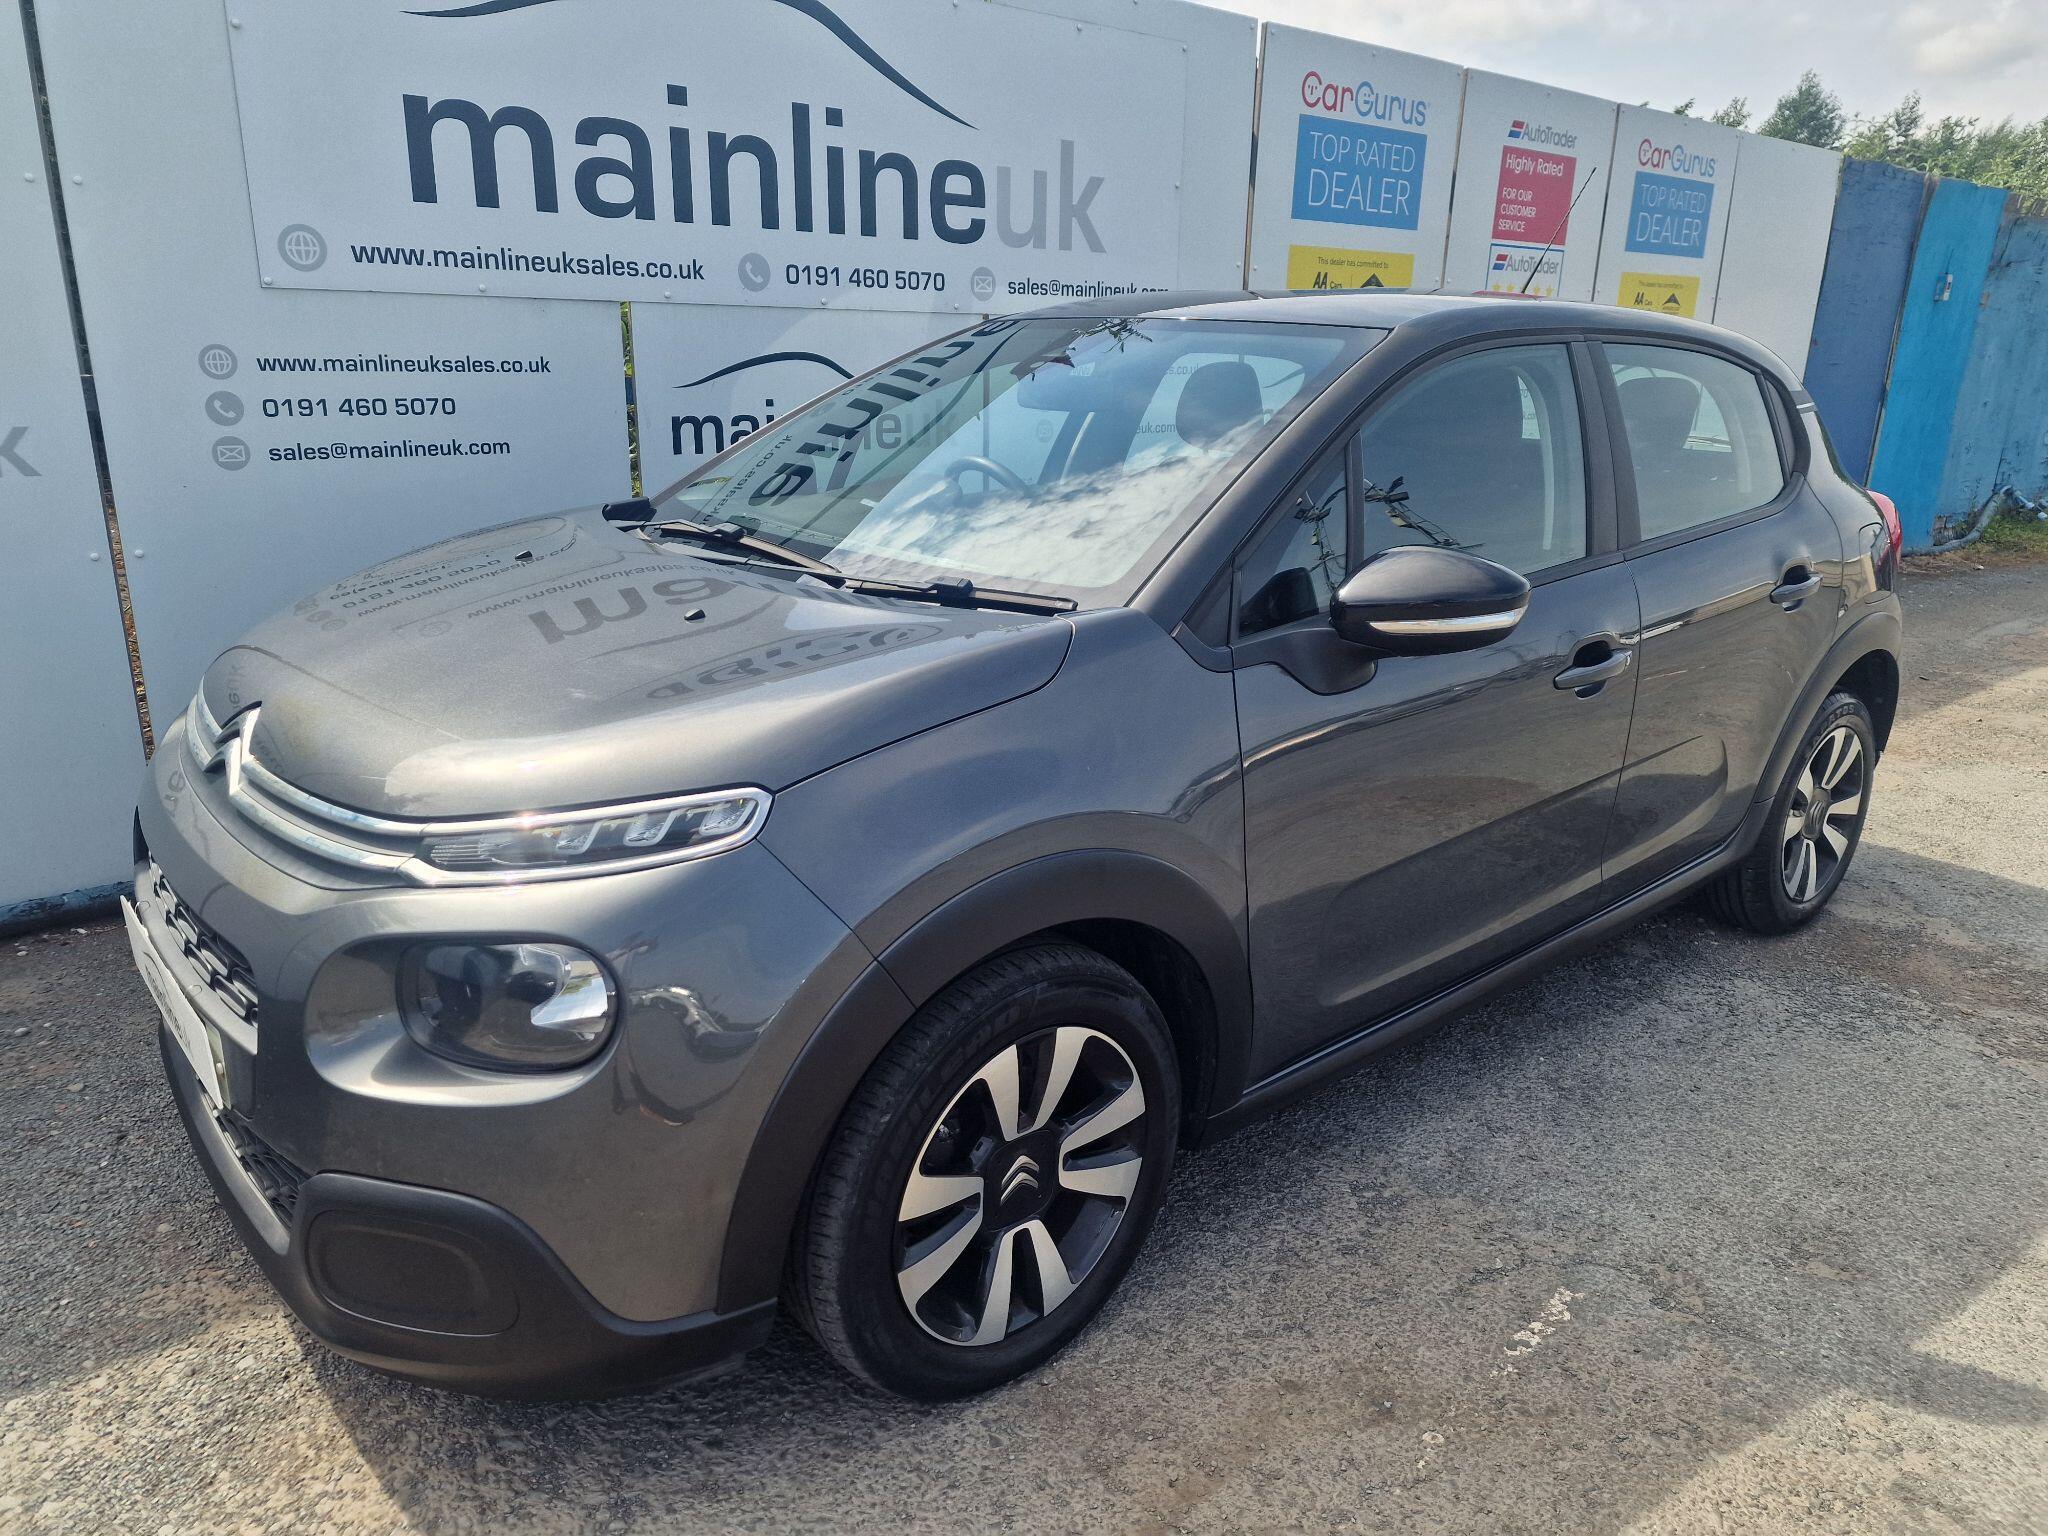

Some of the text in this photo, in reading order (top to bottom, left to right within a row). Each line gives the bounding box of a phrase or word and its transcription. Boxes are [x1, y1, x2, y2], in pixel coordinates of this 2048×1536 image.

[1302, 71, 1427, 126] CarGurus
[1521, 124, 1578, 149] AutoTrader
[1310, 131, 1416, 173] TOP RATED
[1506, 153, 1564, 177] Highly Rated
[1638, 138, 1716, 177] CarGurus
[402, 84, 1107, 253] mainlineuk
[1308, 168, 1411, 216] DEALER
[1502, 187, 1533, 202] FOR OUR
[1641, 184, 1707, 214] TOP RATED
[1500, 203, 1537, 218] CUSTOMER
[1498, 219, 1526, 232] SERVICE
[1636, 211, 1701, 246] DEALER
[350, 244, 705, 281] www.mainlineuksales.co.uk
[785, 264, 946, 293] 0191 460 5070
[1312, 272, 1328, 289] AA
[256, 355, 551, 375] www.mainlineuksales.co.uk
[262, 397, 456, 418] 0191 460 5070
[268, 438, 511, 463] sales@mainlineuk.com
